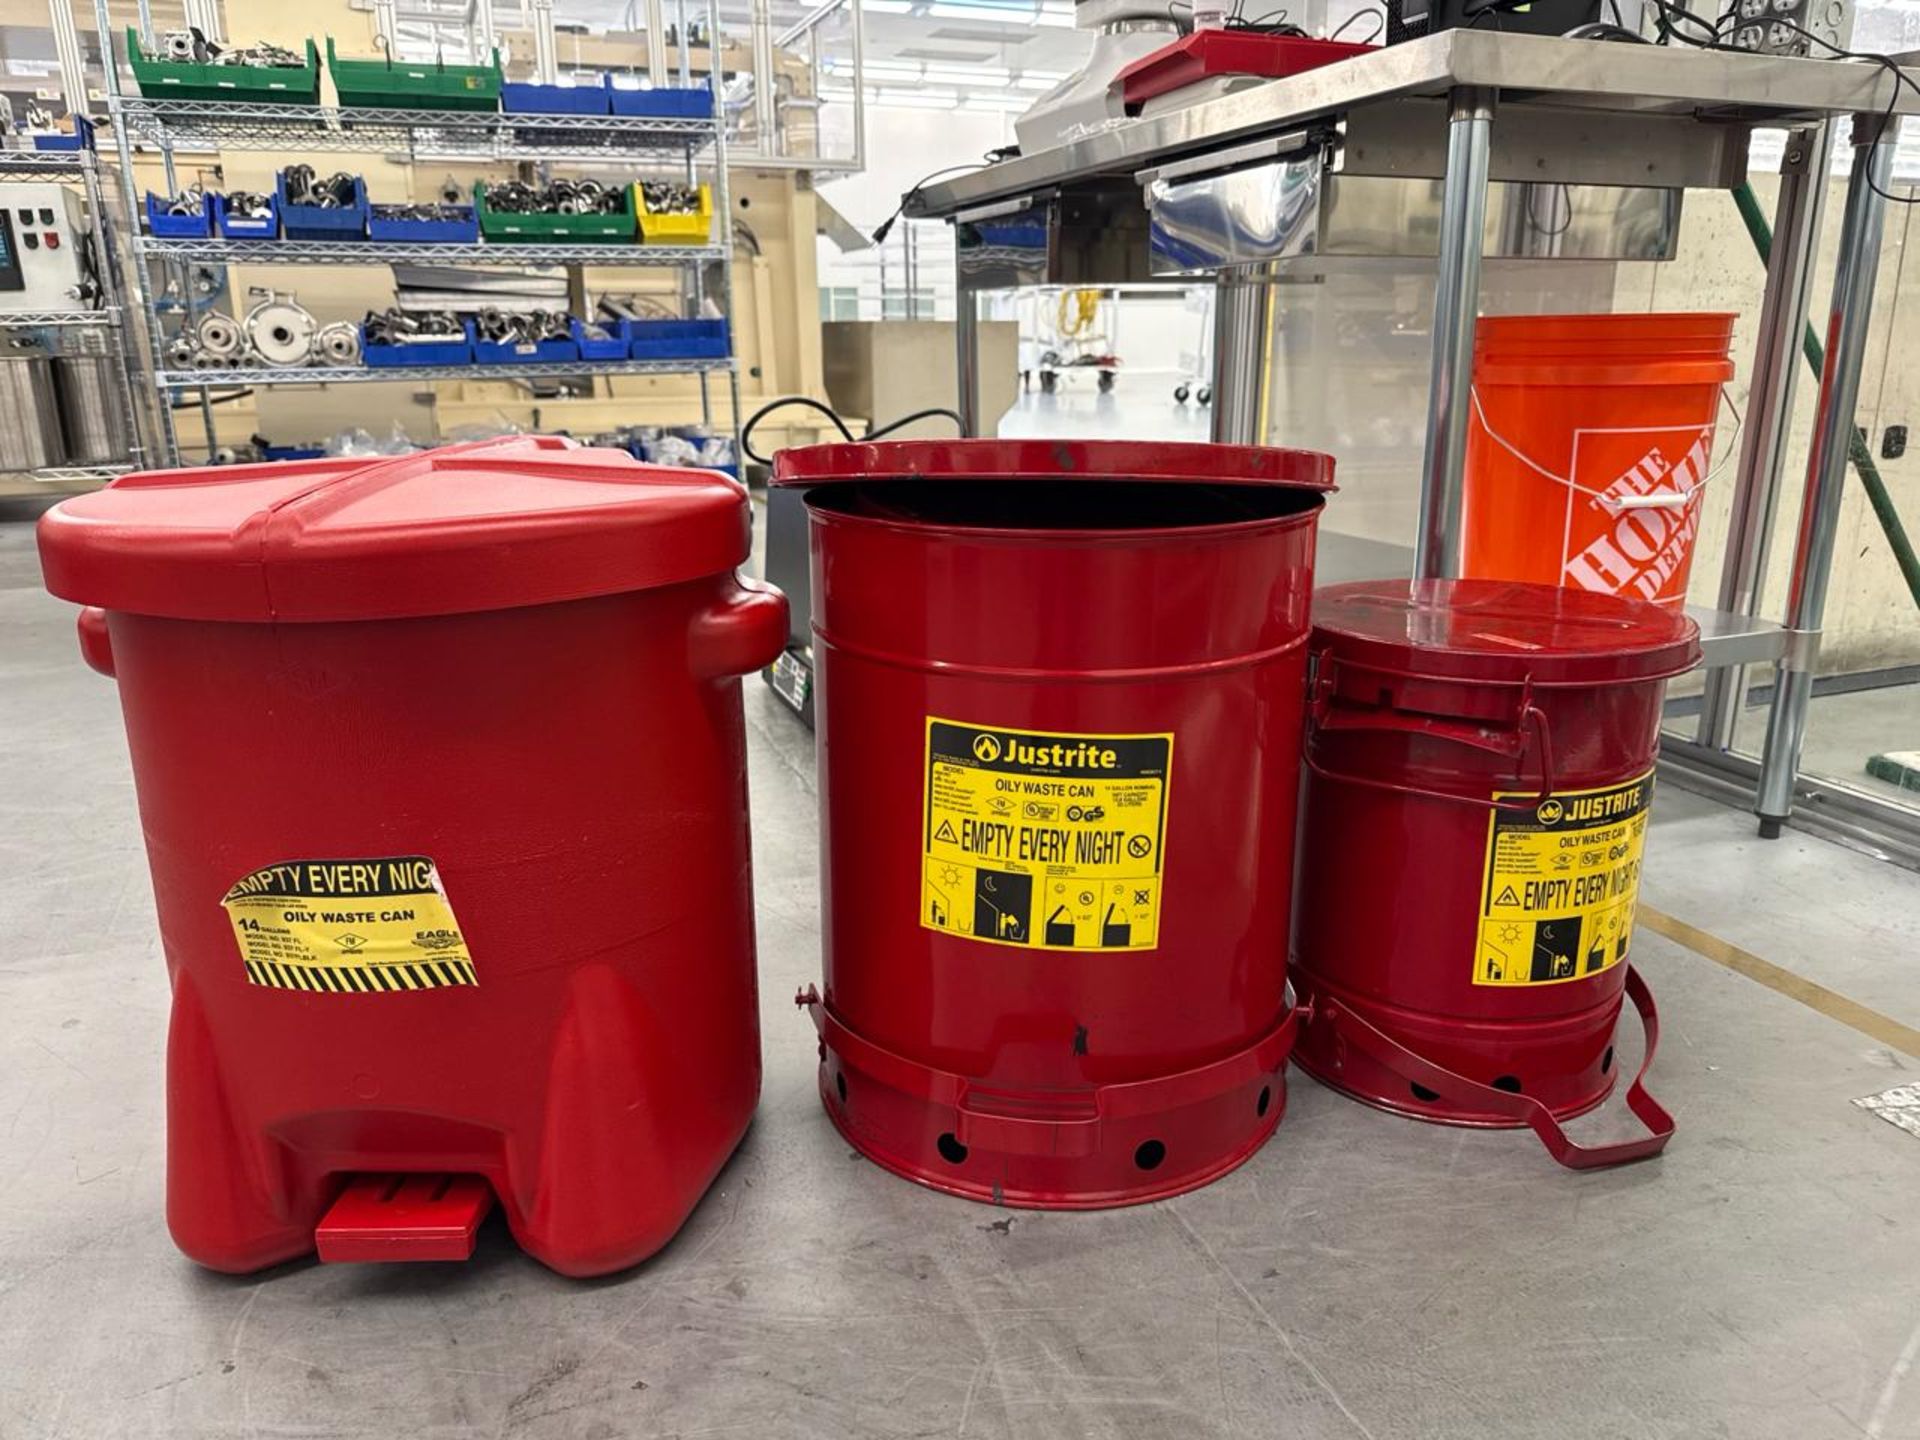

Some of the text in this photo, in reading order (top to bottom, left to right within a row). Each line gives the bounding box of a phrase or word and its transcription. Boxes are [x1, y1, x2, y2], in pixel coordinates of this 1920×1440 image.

[1589, 447, 1672, 520] THE
[1003, 739, 1117, 769] Justrite
[995, 778, 1095, 798] OILY WASTE CAN
[1564, 786, 1641, 822] JUSTRITE
[961, 818, 1124, 865] EMPTY EVERY NIGHT
[1559, 834, 1581, 849] OILY
[1581, 831, 1611, 847] WASTE
[1611, 827, 1626, 840] CAN
[227, 861, 437, 898] EMPTY EVERY NIG
[1523, 879, 1572, 911] EMPTY
[1573, 872, 1611, 907] EVERY
[238, 918, 260, 932] 14
[283, 909, 415, 923] OILY WASTE CAN
[415, 929, 460, 940] EAGLE
